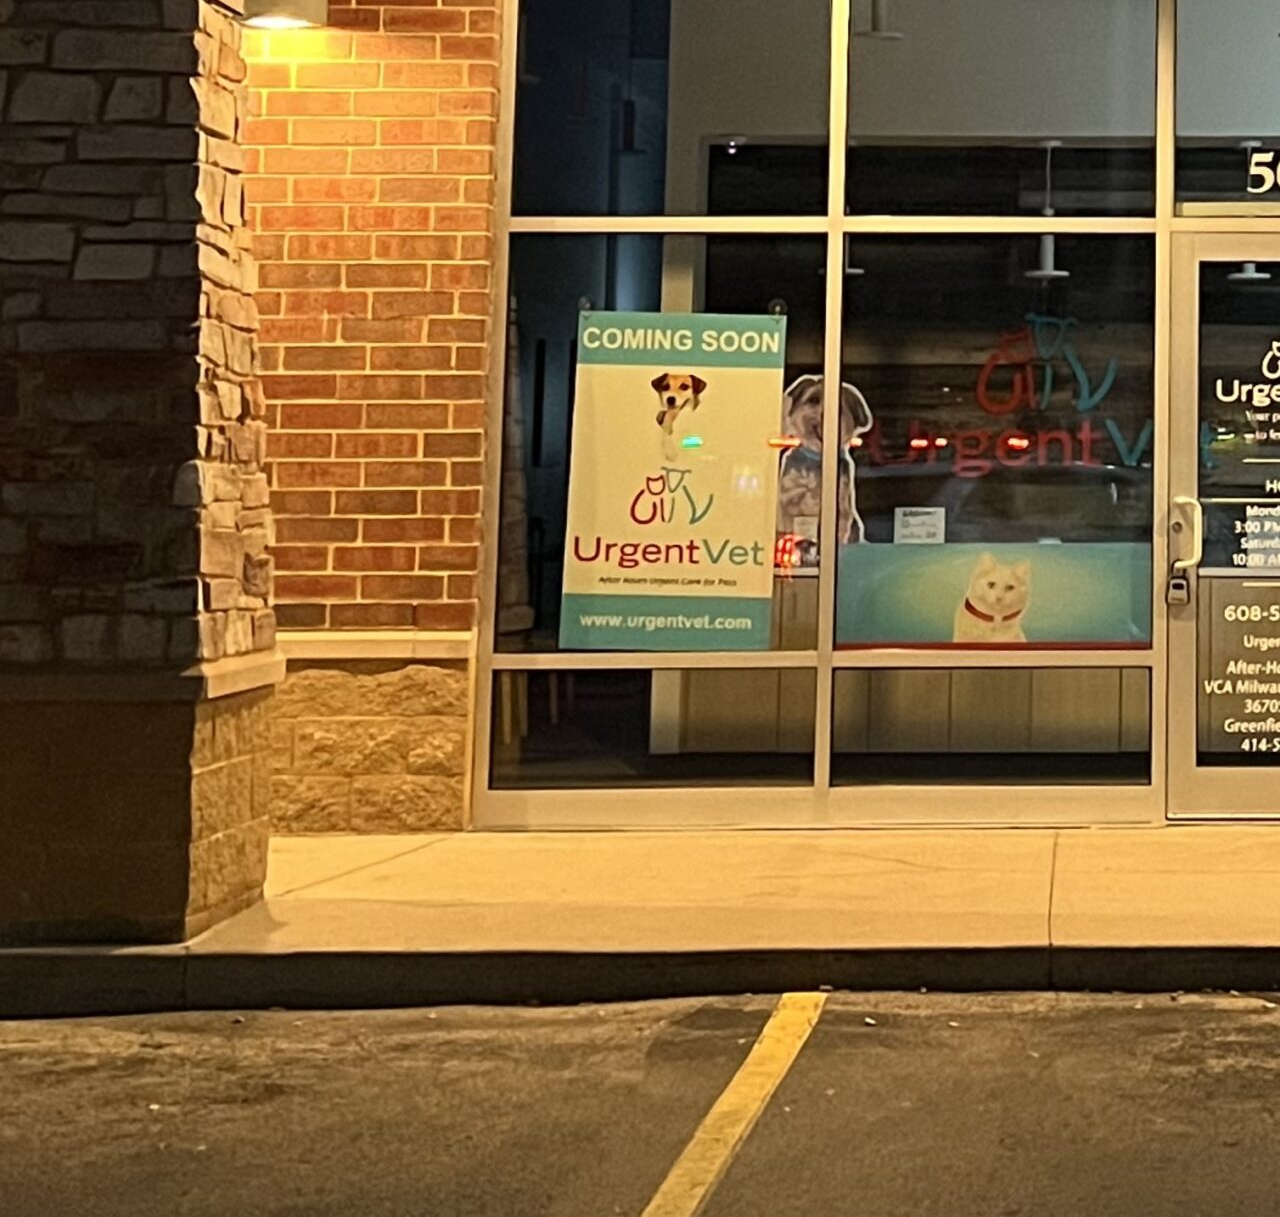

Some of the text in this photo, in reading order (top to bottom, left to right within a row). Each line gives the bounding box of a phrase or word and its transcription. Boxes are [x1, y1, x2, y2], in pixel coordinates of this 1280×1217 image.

[582, 327, 780, 353] COMING SOON
[1234, 521, 1260, 533] 3:00
[574, 536, 765, 568] UrgentVet
[580, 614, 752, 631] www.urgentvet.com
[1204, 680, 1233, 694] VCA
